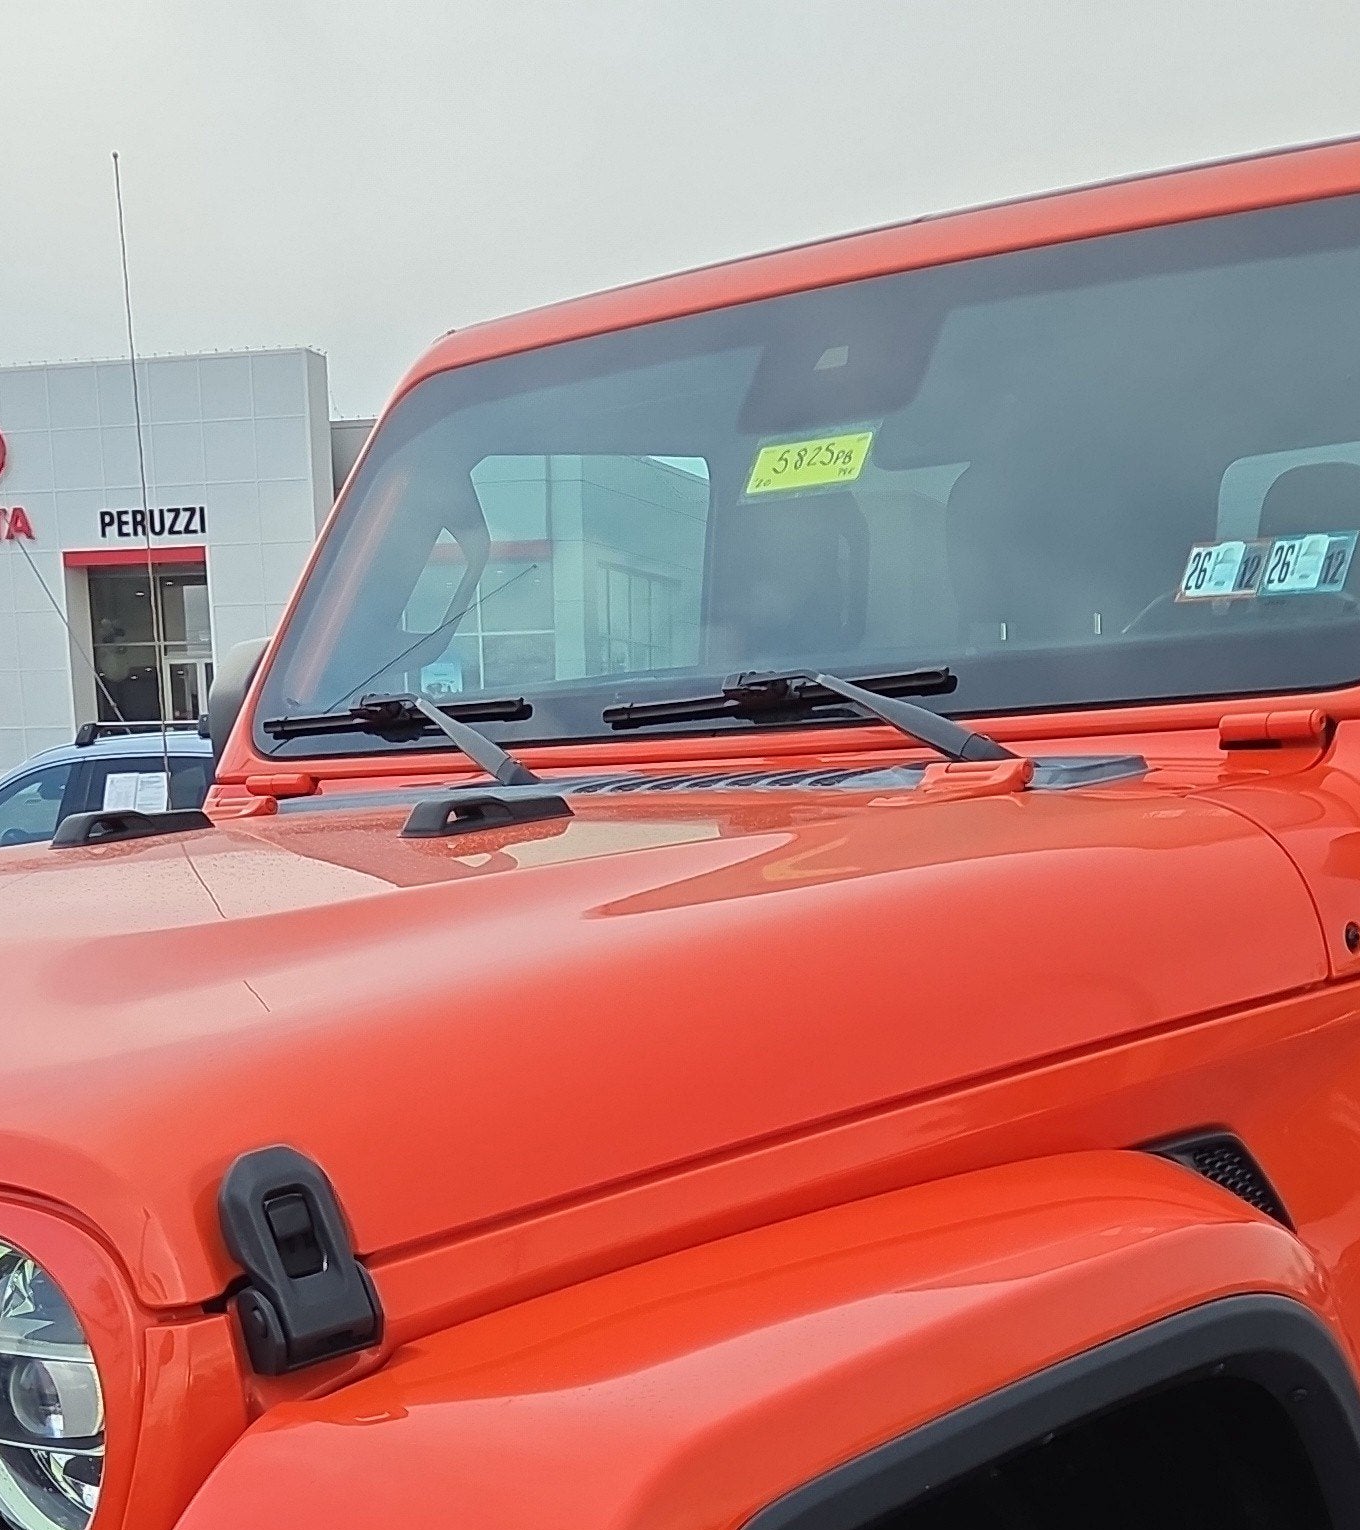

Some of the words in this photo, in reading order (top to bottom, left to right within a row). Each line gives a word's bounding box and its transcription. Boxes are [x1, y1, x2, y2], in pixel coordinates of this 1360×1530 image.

[99, 506, 207, 539] PERUZZI
[1184, 551, 1213, 591] 26
[1238, 555, 1262, 589] 12
[1267, 543, 1296, 585] 26
[1321, 550, 1346, 585] 12
